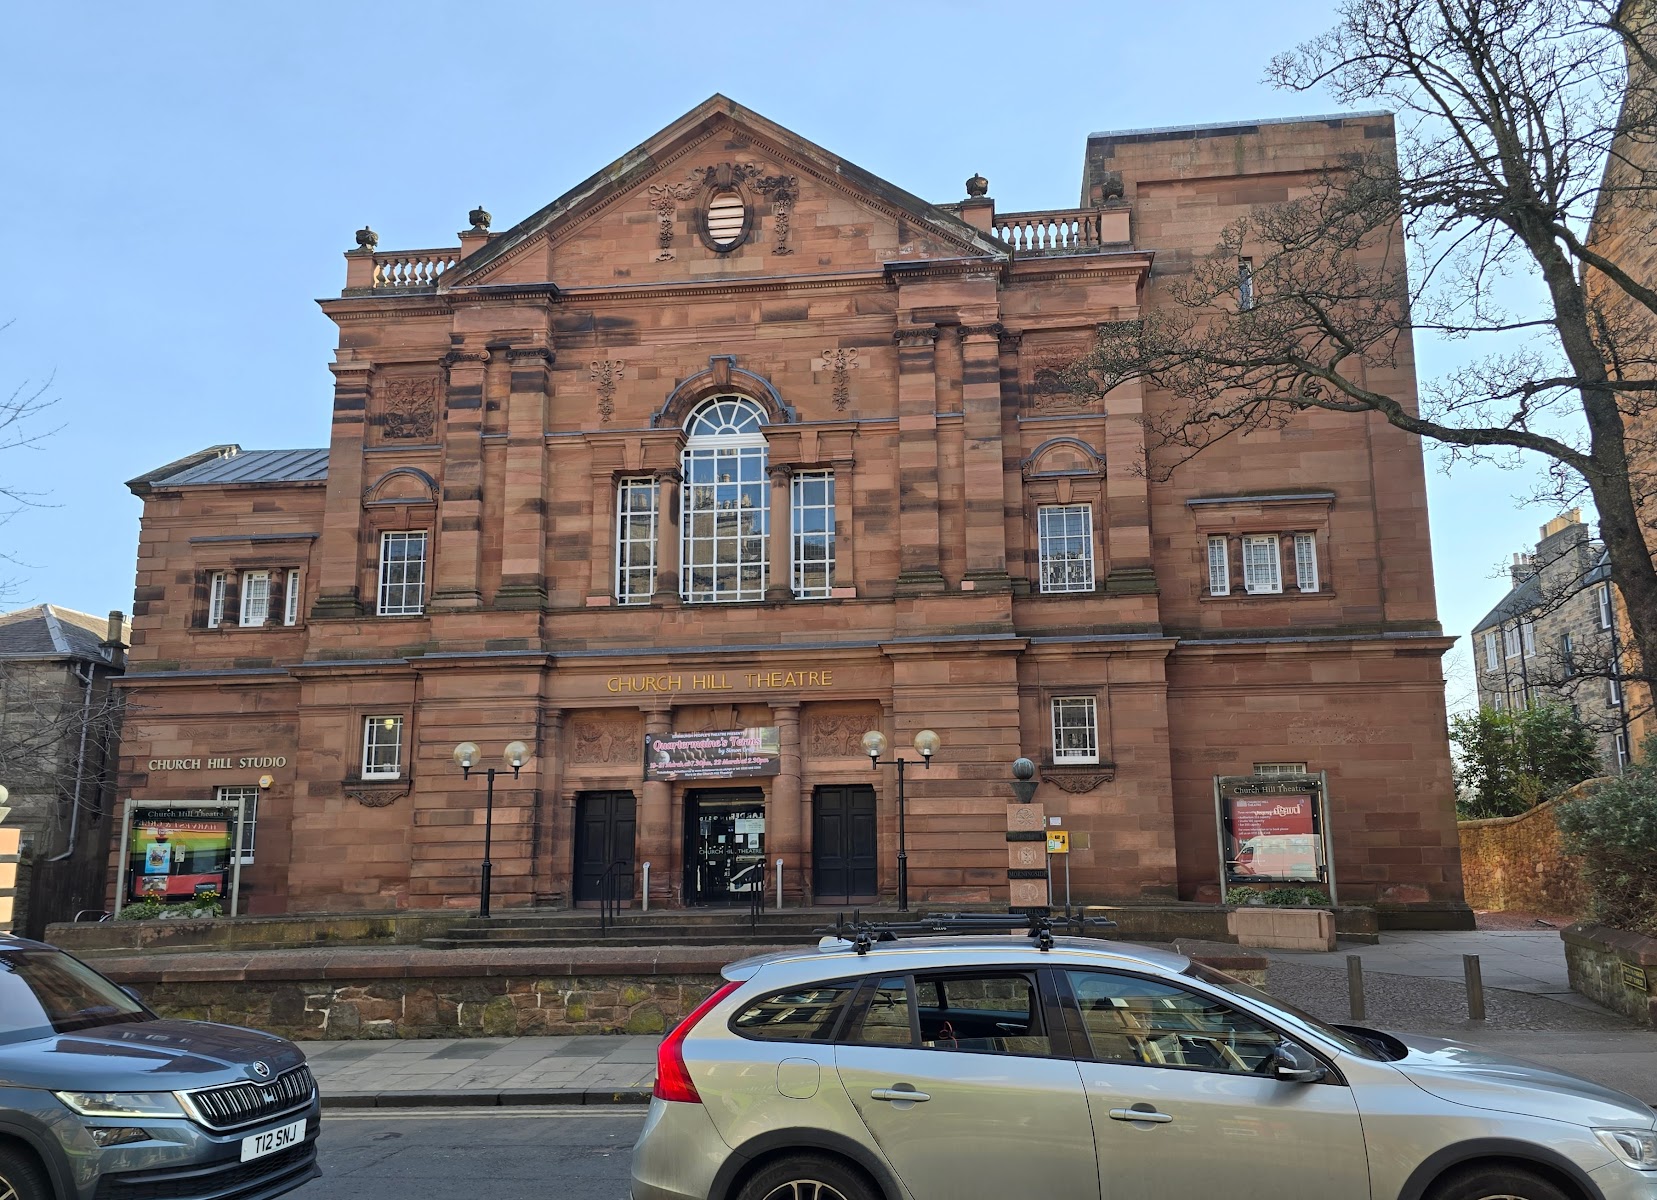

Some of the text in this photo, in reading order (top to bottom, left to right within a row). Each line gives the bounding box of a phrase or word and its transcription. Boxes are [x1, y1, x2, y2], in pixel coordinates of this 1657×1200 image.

[607, 670, 833, 692] CHURCH HILL THEATRE
[653, 736, 762, 752] Quartermaine's Terms
[148, 756, 286, 771] CHURCH HILL STUDIO
[1234, 786, 1260, 794] Church
[1009, 870, 1048, 878] MORNINGSIDE
[255, 1124, 297, 1154] T12 SNJ
